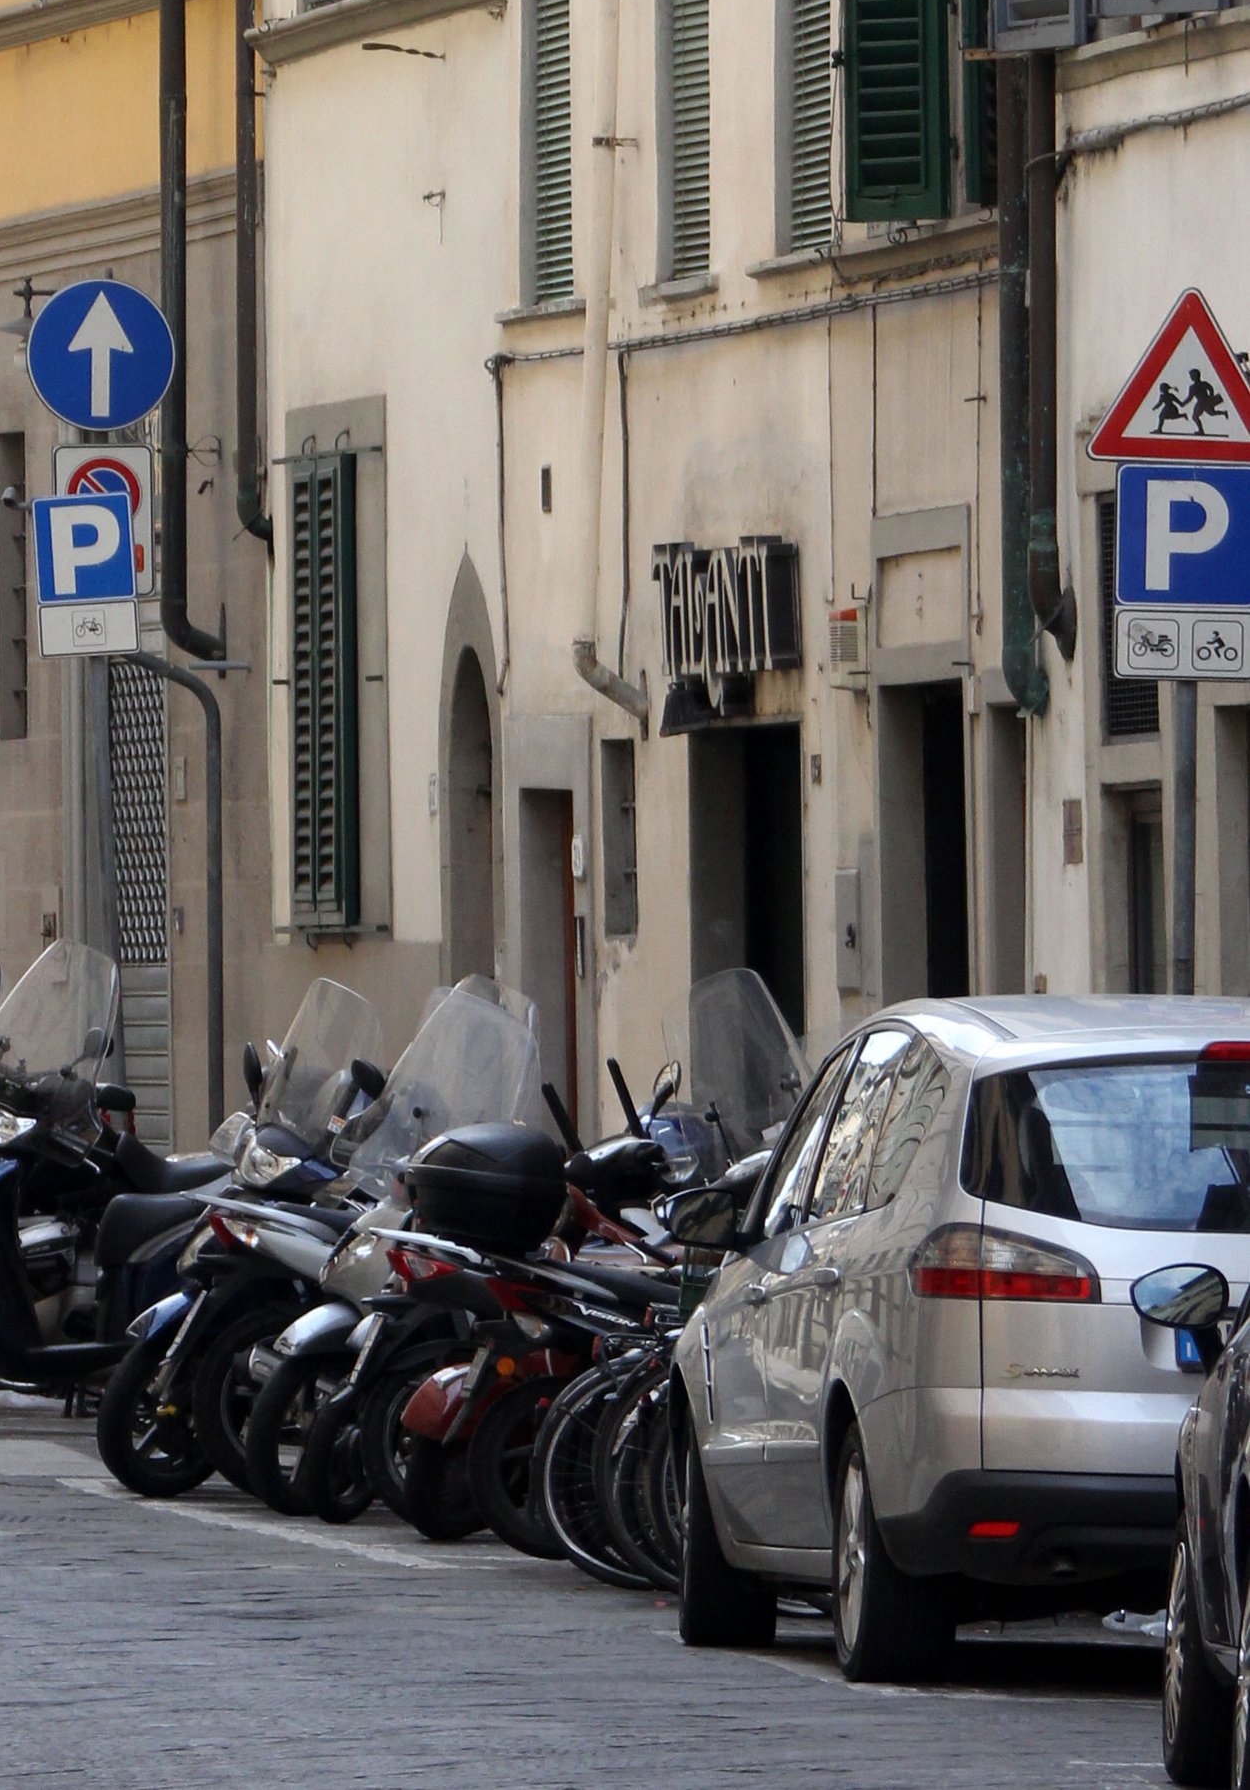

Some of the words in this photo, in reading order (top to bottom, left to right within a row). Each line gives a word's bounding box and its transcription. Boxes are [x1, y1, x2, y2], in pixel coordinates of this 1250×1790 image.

[49, 504, 121, 596] P
[1144, 479, 1230, 591] P
[572, 1300, 641, 1328] VISION
